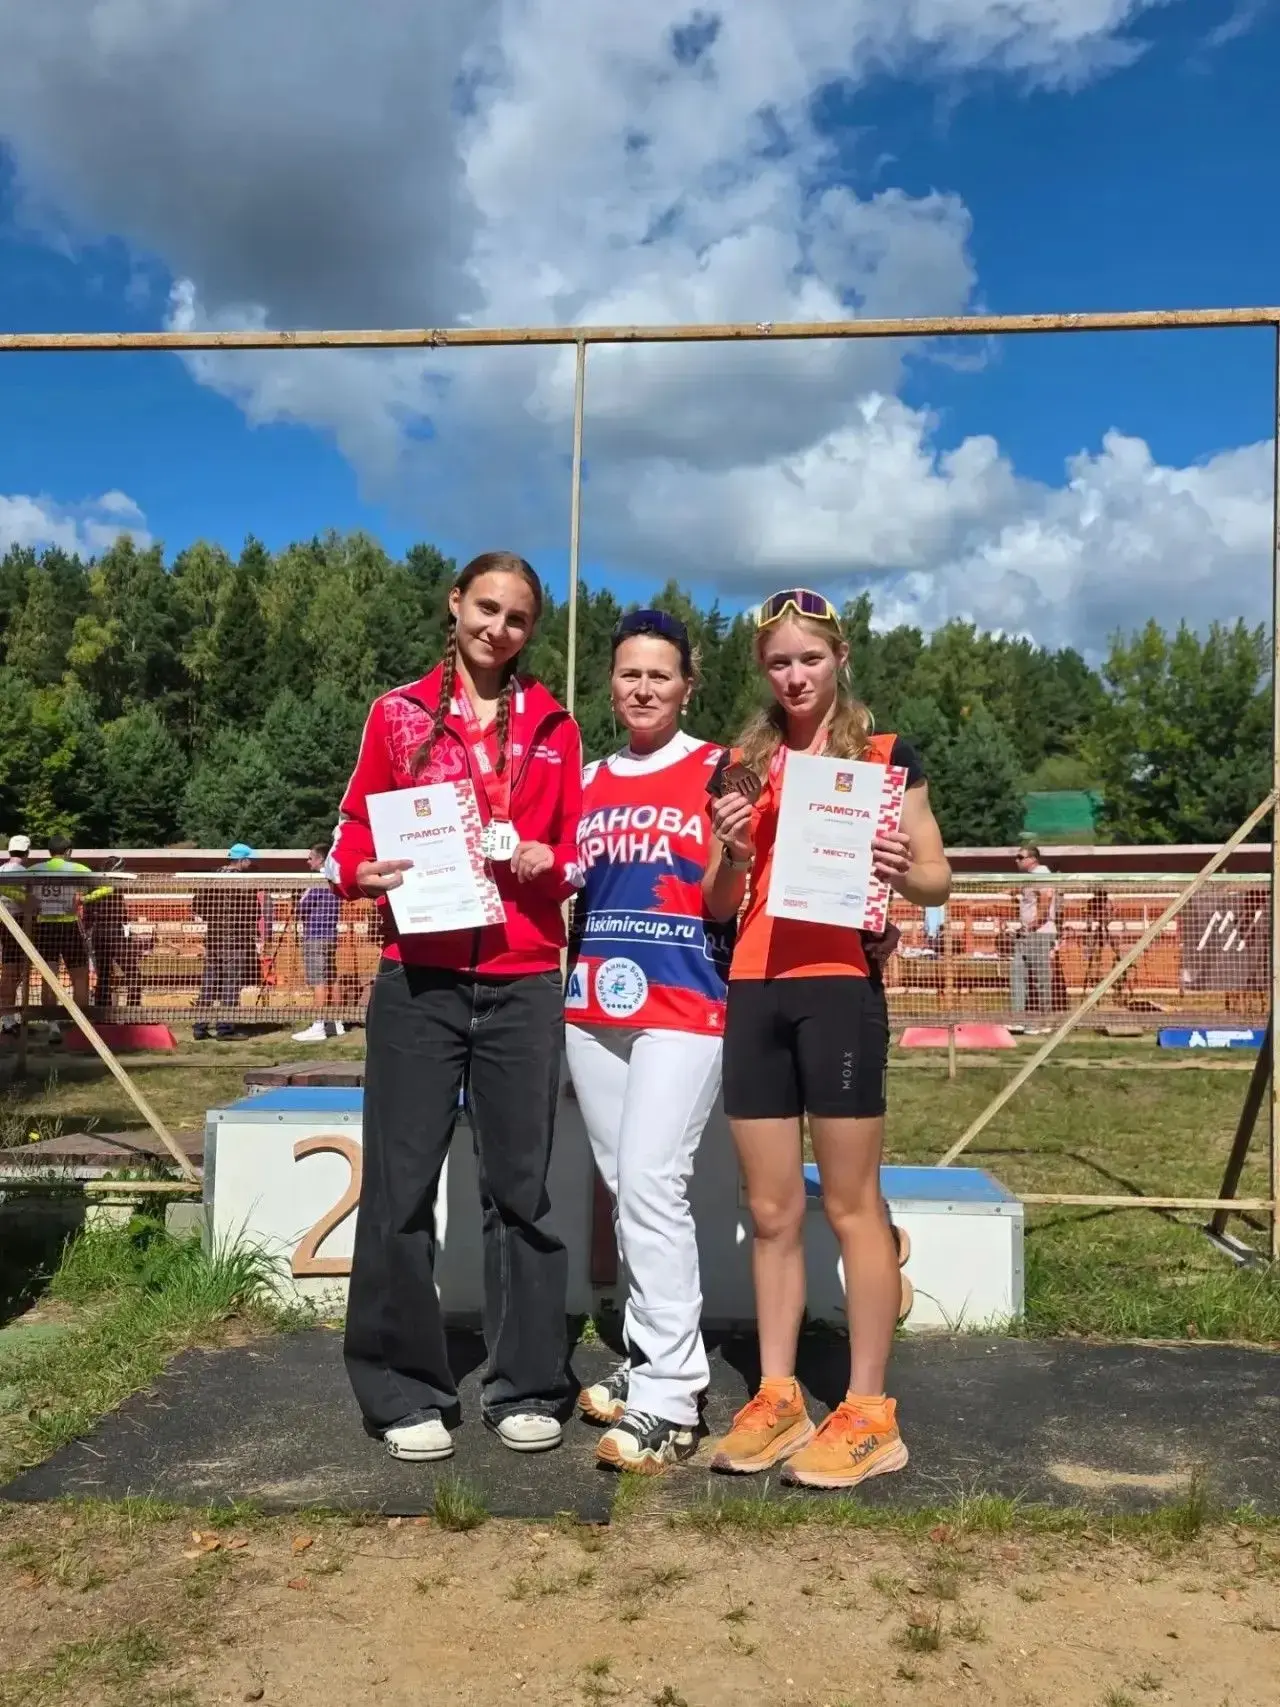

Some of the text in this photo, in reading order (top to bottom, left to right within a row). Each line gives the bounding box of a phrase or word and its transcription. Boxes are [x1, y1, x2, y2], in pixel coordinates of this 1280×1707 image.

[808, 802, 872, 820] ГРАМОТА
[399, 824, 457, 842] ГРАМОТА
[822, 848, 856, 859] МЕСТО
[842, 1052, 853, 1090] MOAX
[291, 1134, 364, 1279] 2
[849, 1434, 879, 1463] HOKA
